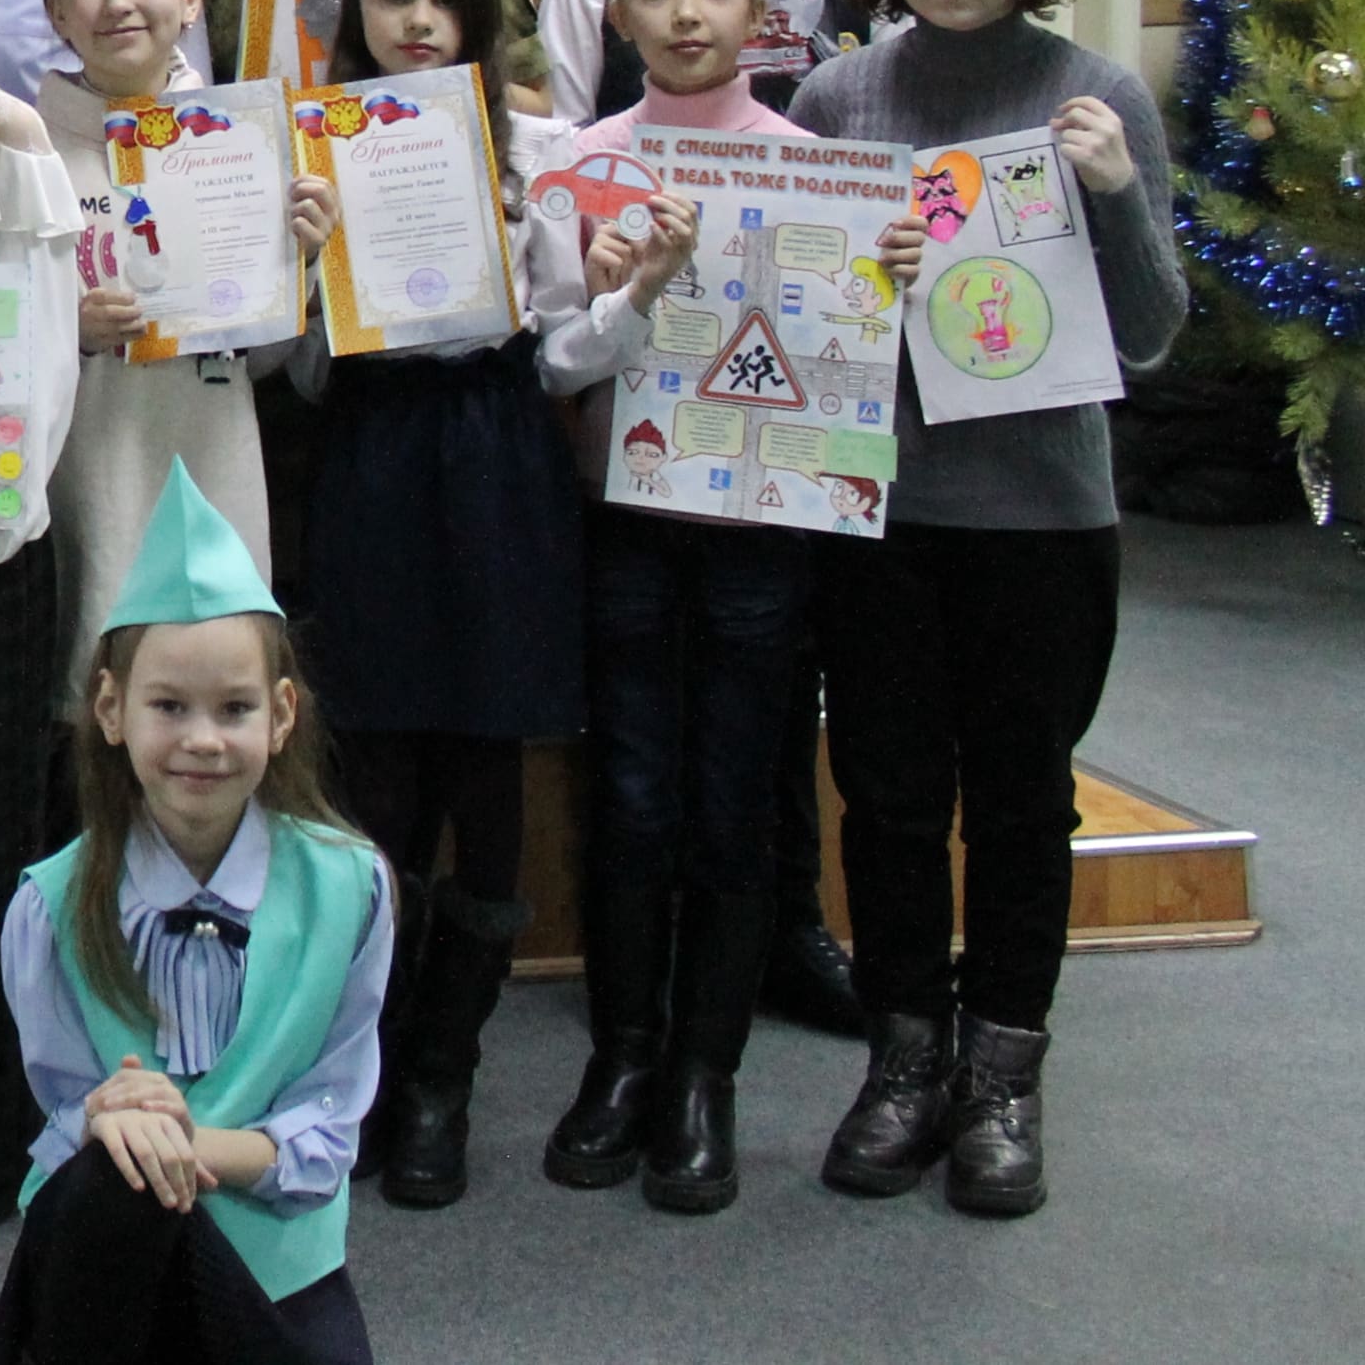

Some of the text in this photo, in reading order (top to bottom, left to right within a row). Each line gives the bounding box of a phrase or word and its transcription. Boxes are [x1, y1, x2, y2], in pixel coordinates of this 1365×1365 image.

[162, 142, 253, 175] Грамота
[350, 130, 444, 165] Грамота
[640, 137, 893, 170] НЕ СПЕШИТЕ ВОДИТЕЛИ!
[672, 167, 726, 187] ВЕДЬ
[730, 170, 787, 189] ТОЖЕ
[793, 175, 906, 201] РОДИТЕЛИ!
